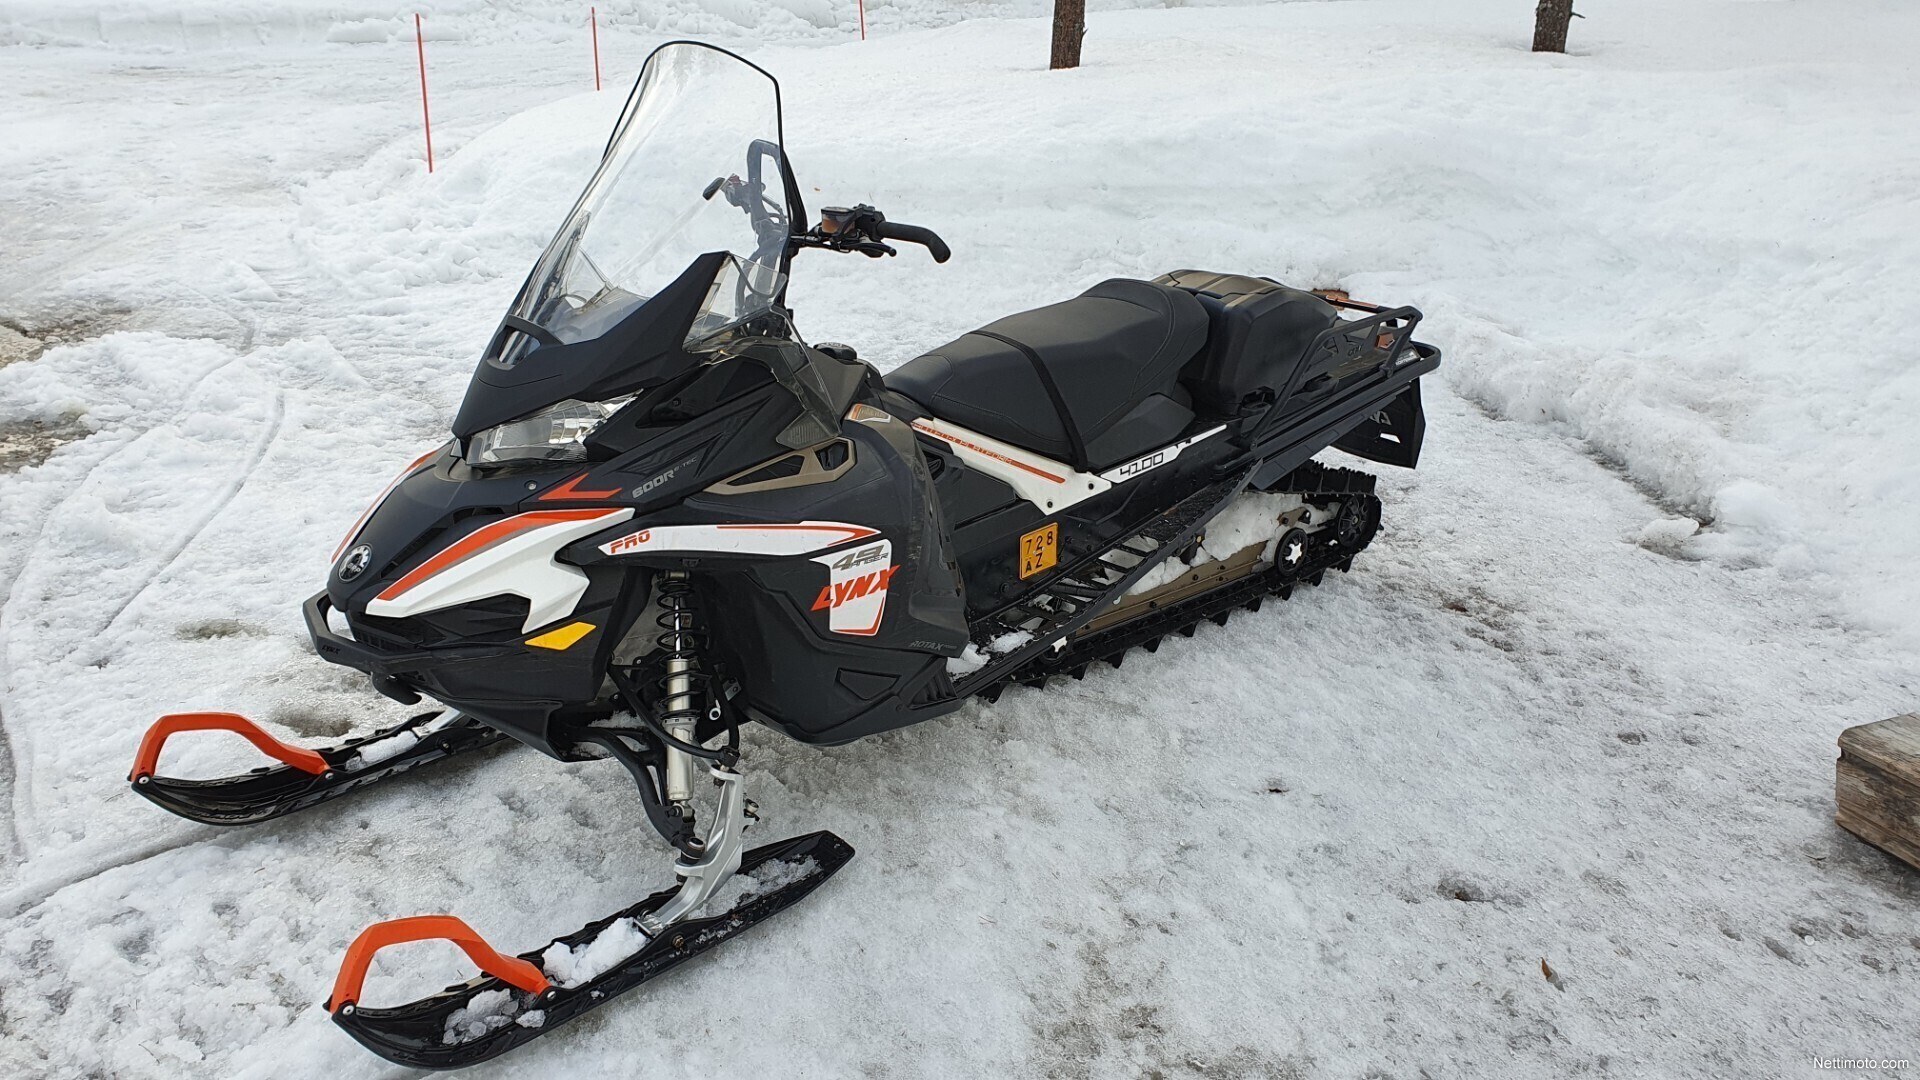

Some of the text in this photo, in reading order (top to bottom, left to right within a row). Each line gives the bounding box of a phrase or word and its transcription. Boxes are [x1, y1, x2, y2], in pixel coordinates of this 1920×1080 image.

[1119, 452, 1164, 476] 4100
[631, 469, 675, 499] 600R
[610, 530, 651, 554] PRO
[1025, 530, 1053, 555] 728
[832, 545, 884, 571] 49
[810, 564, 901, 612] LYNX
